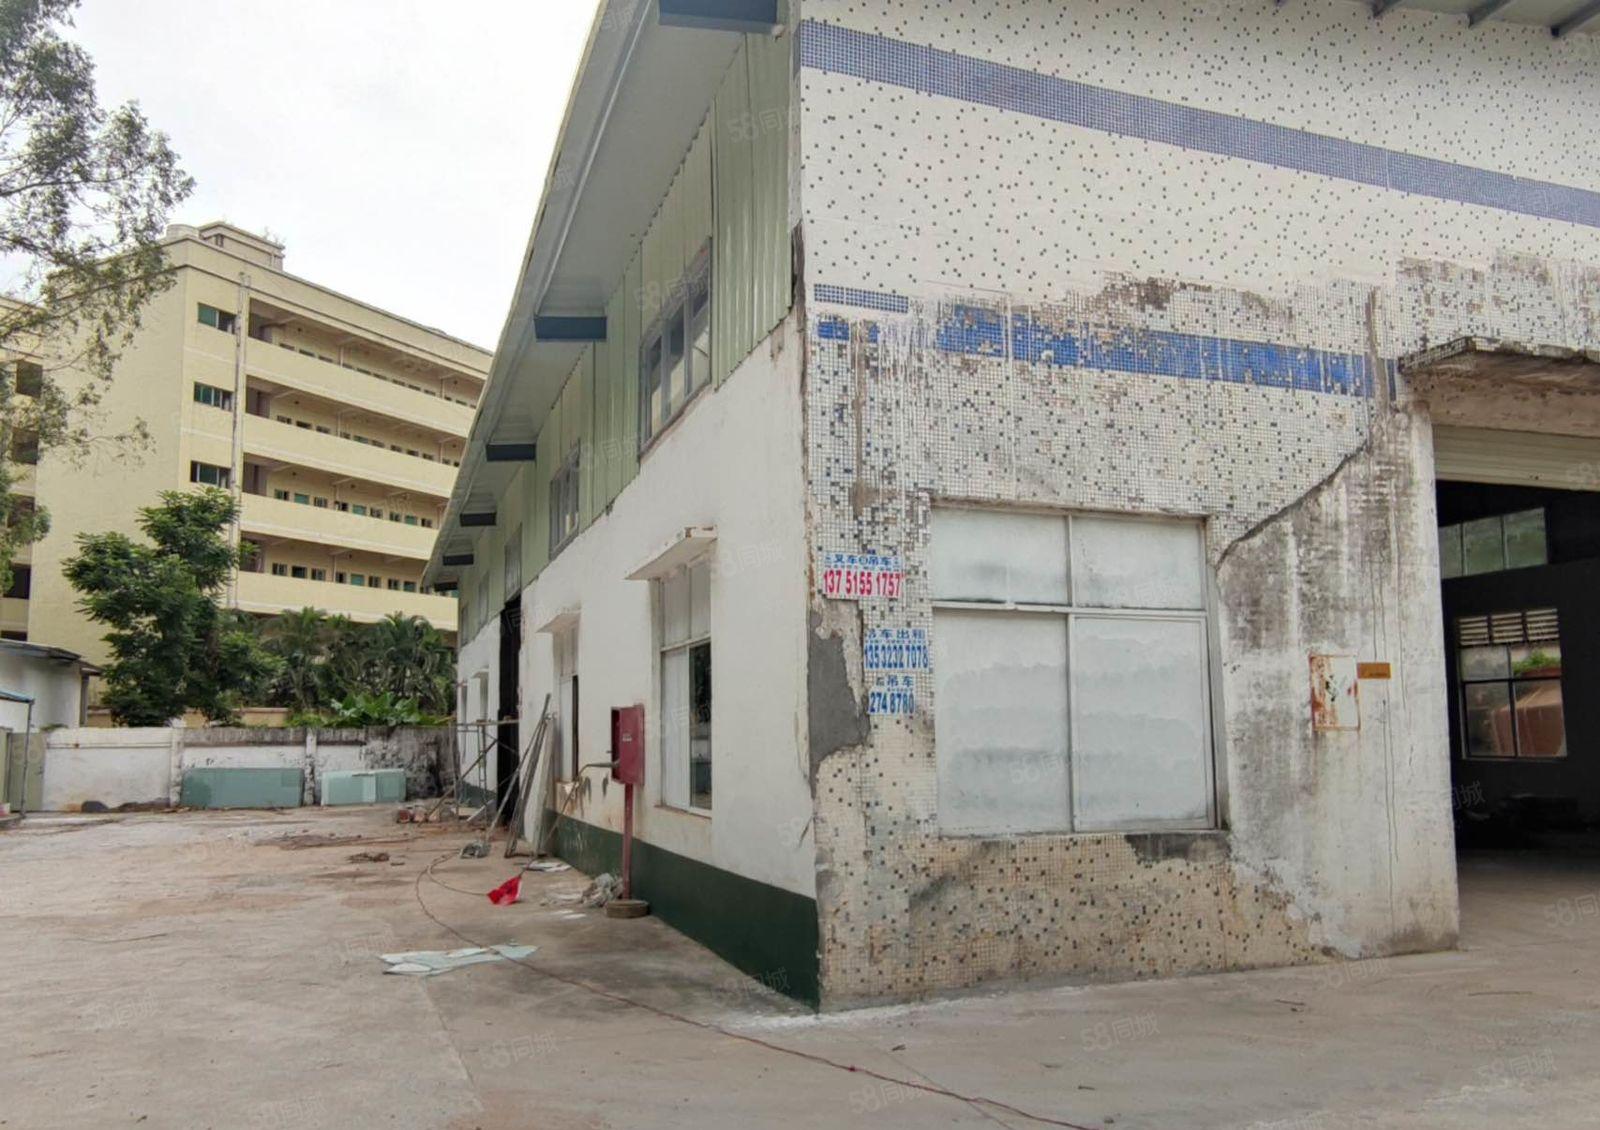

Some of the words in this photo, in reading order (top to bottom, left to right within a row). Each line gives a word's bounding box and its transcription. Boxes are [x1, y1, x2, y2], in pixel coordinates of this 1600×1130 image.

[823, 570, 842, 594] 137
[846, 571, 873, 596] 5155
[876, 572, 900, 597] 1757
